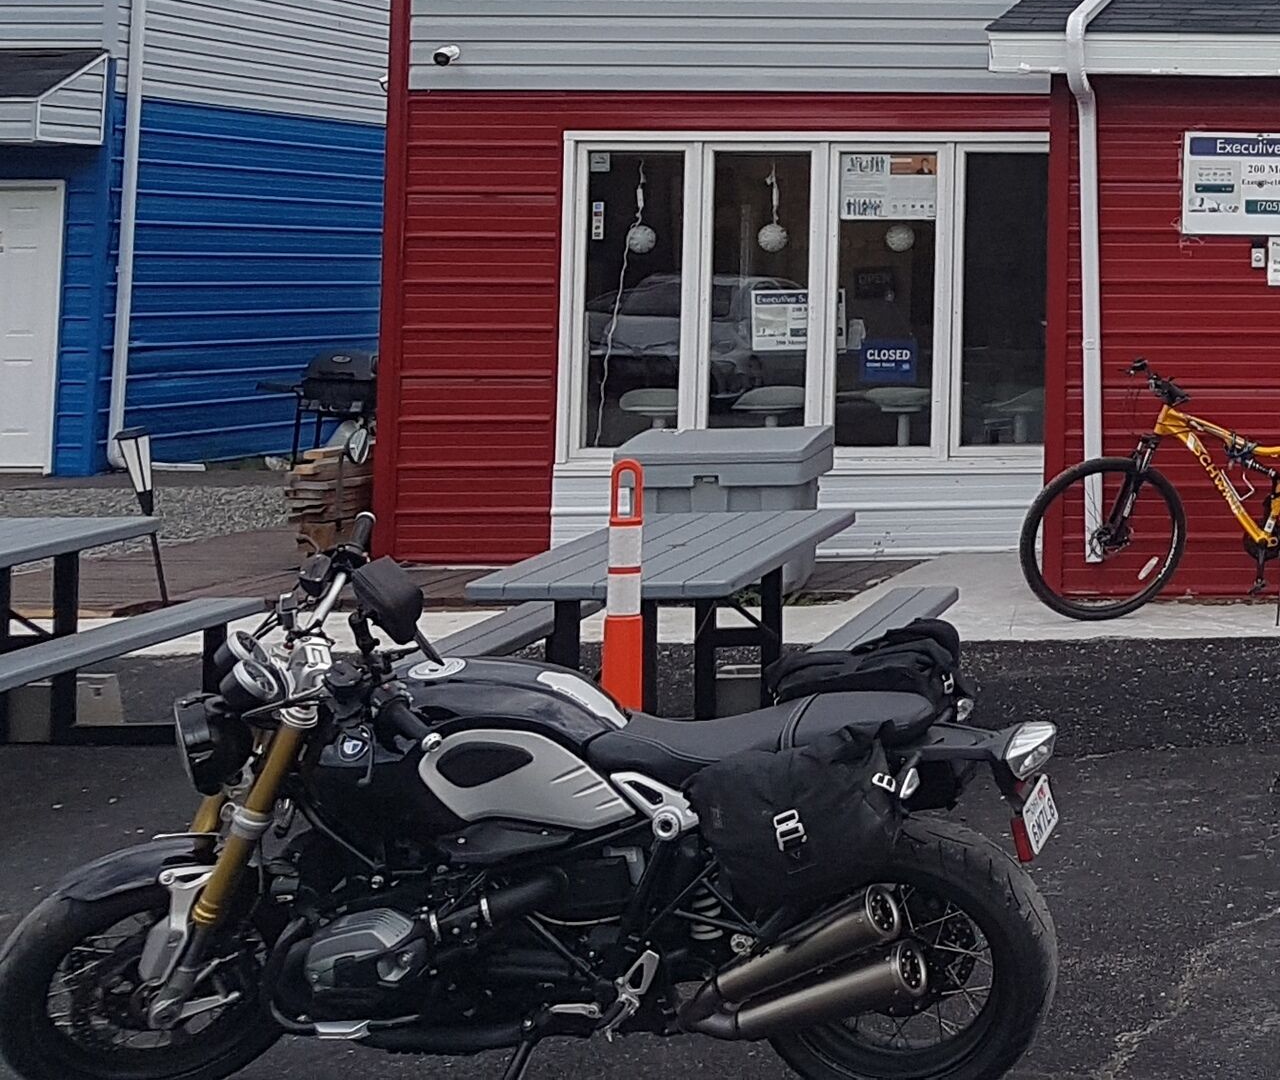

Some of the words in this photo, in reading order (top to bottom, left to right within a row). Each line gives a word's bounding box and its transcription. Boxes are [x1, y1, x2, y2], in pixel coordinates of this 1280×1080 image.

[1247, 165, 1265, 174] 200
[1257, 201, 1280, 212] (705)
[756, 295, 797, 304] Executive
[866, 349, 911, 361] CLOSED
